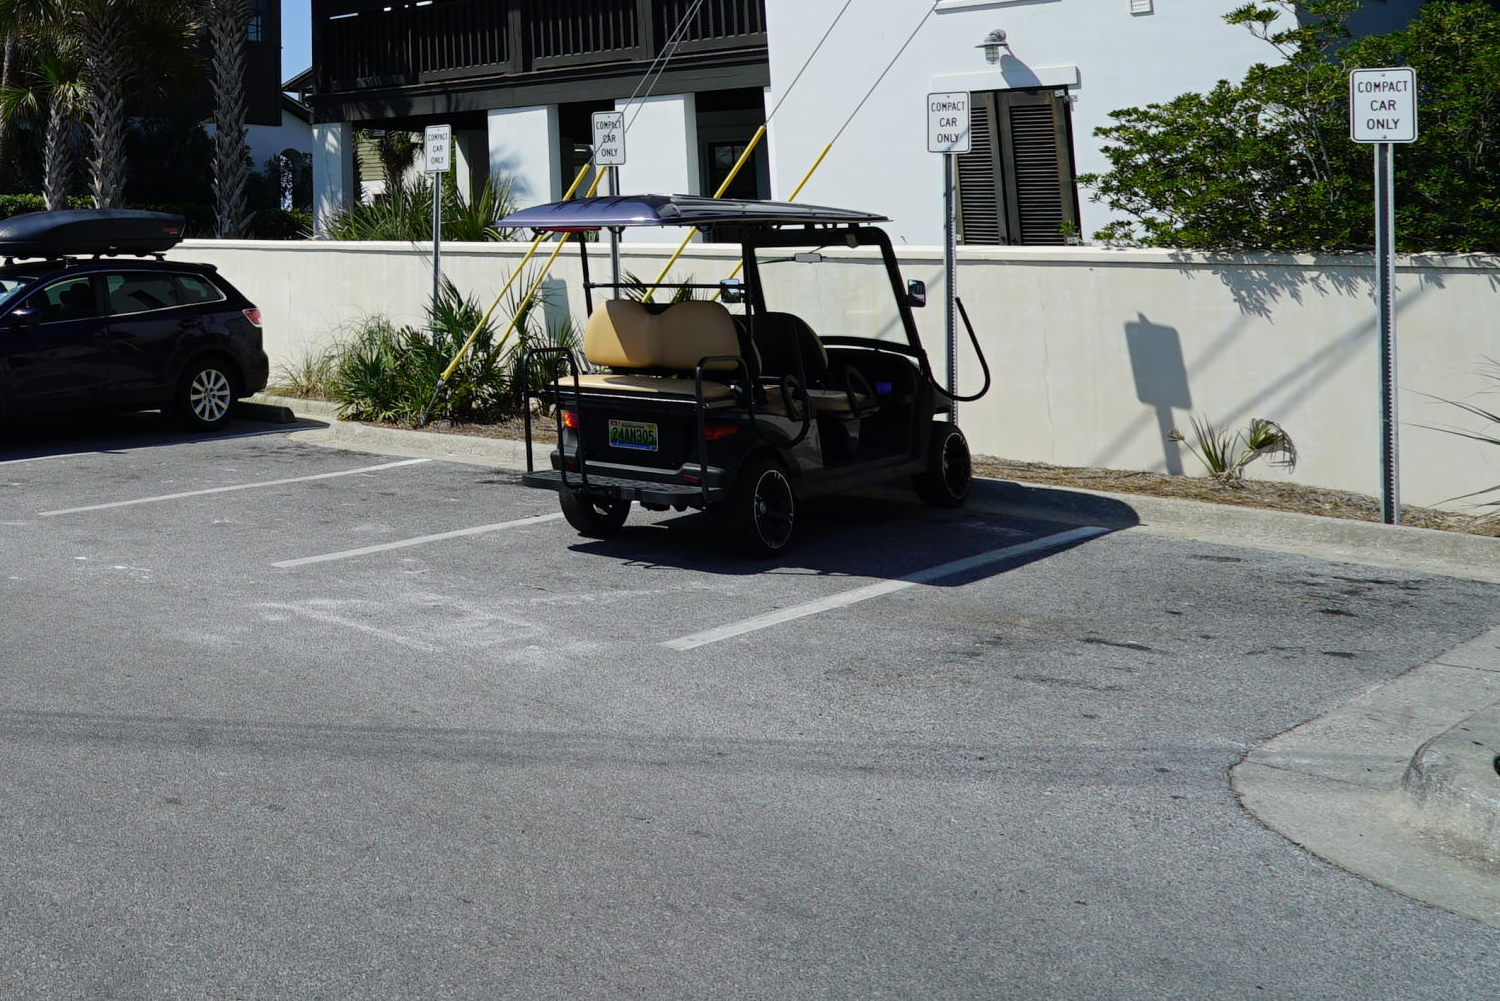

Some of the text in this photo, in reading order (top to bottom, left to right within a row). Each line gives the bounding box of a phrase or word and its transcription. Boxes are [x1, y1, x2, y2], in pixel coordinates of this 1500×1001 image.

[1357, 80, 1408, 94] COMPACT
[931, 101, 965, 113] COMPACT
[1370, 99, 1397, 112] CAR
[596, 120, 621, 130] COMPACT
[939, 117, 957, 128] CAR
[1366, 118, 1400, 131] ONLY
[428, 133, 447, 141] COMPACT
[603, 134, 616, 143] CAR
[936, 133, 960, 144] ONLY
[433, 145, 444, 153] CAR
[601, 148, 618, 157] ONLY
